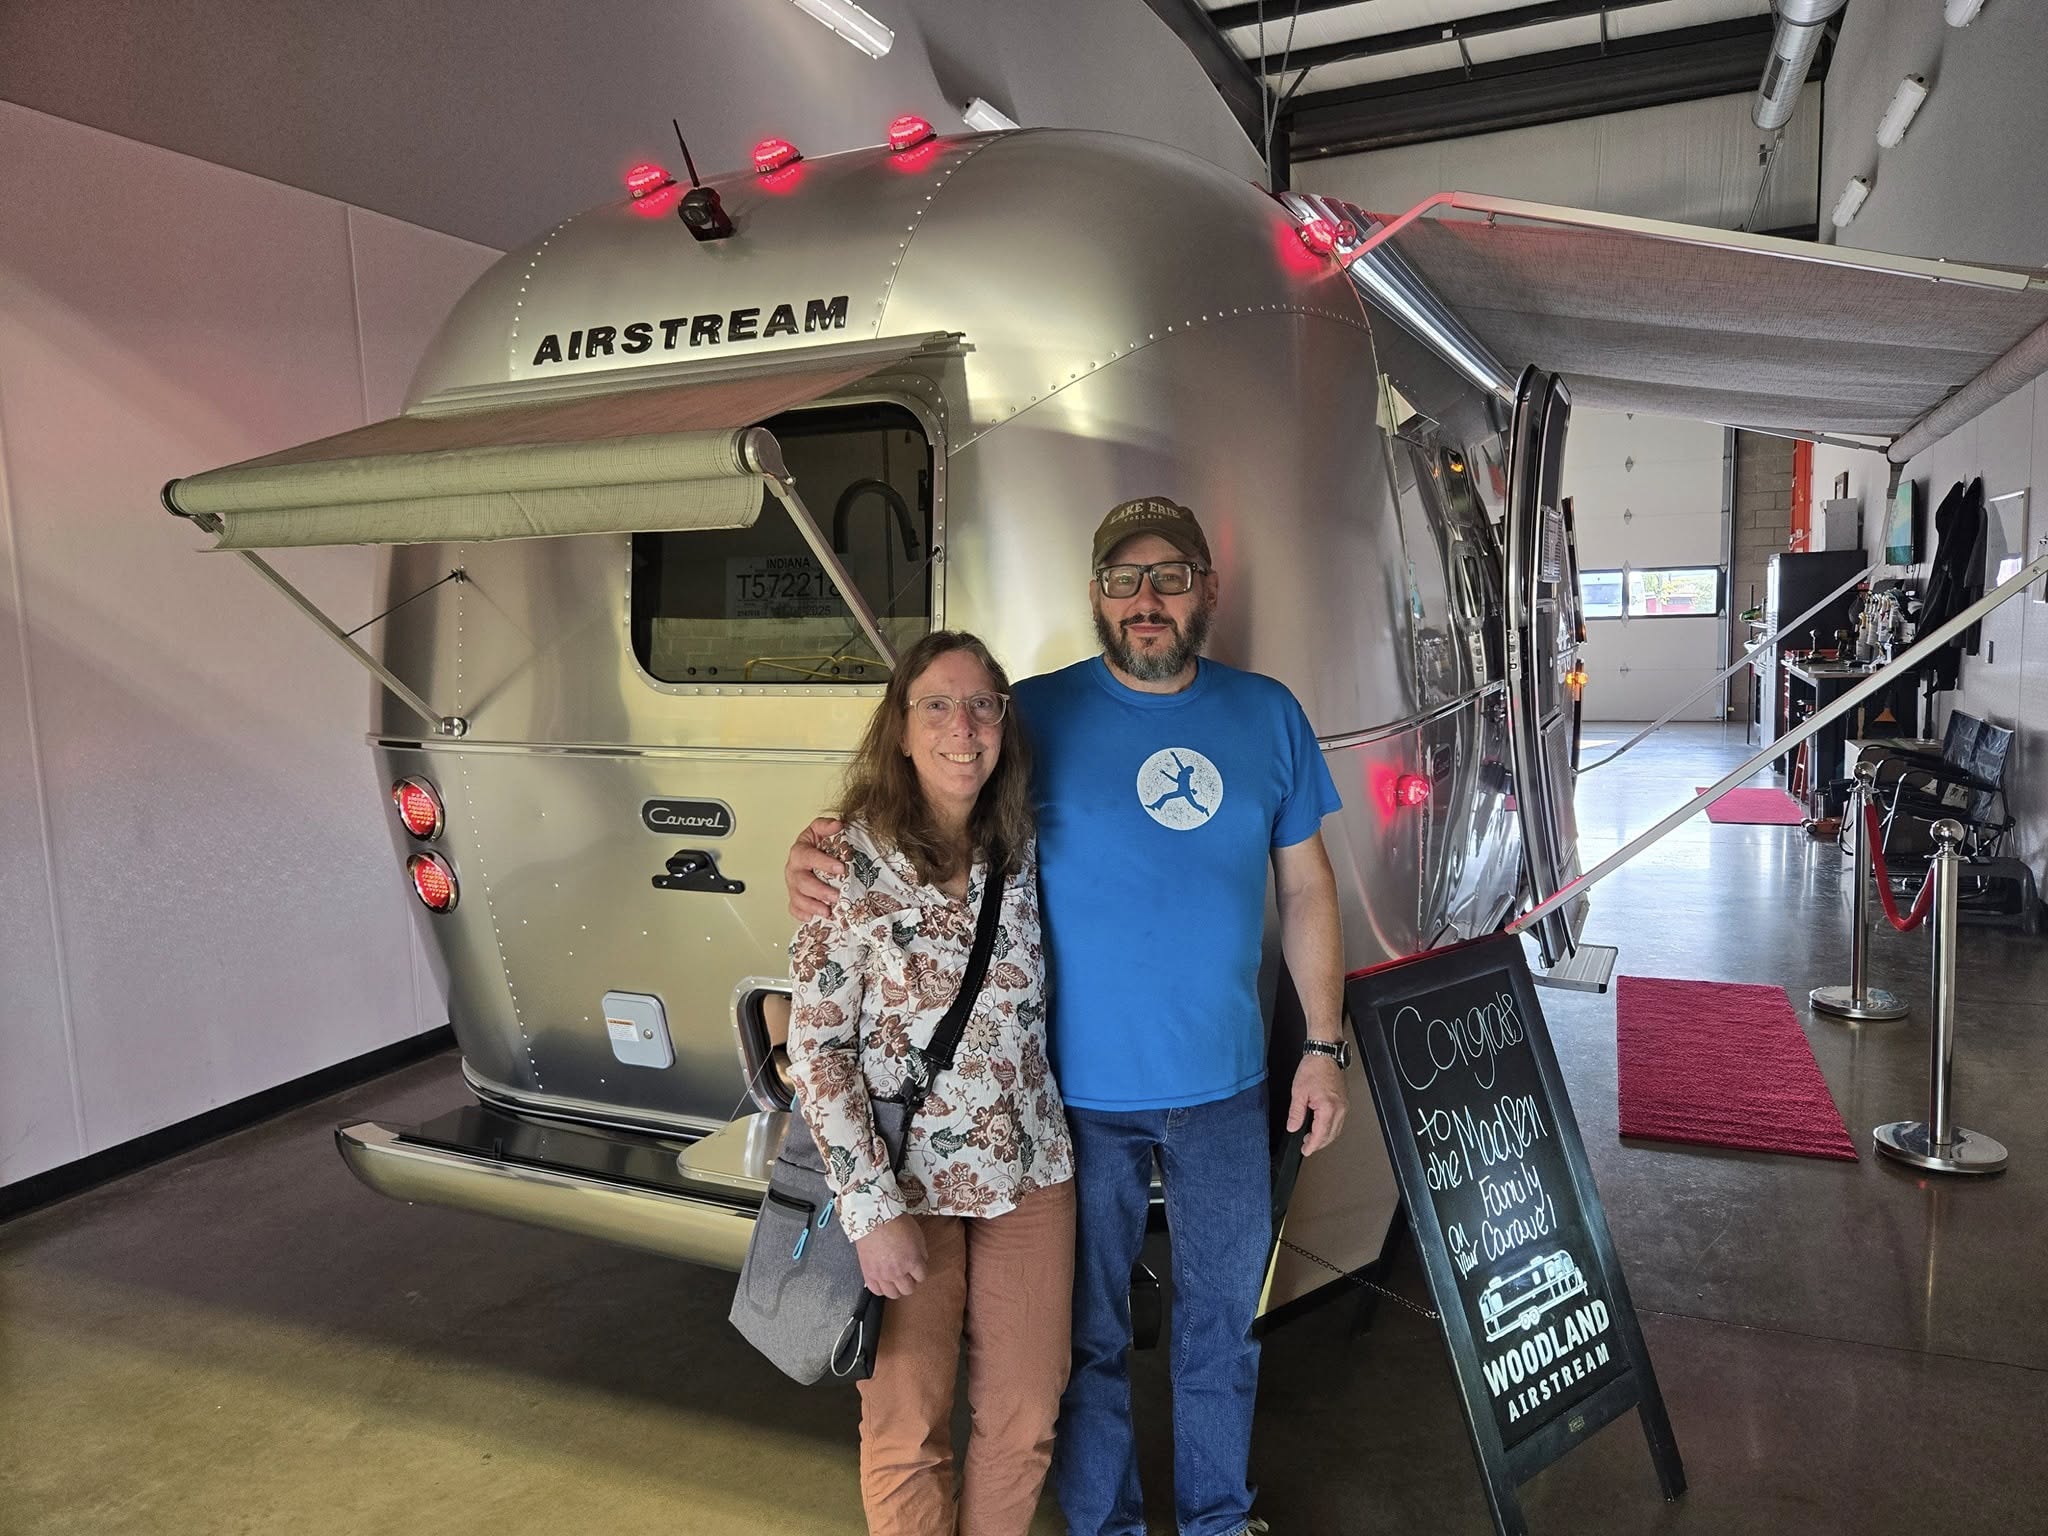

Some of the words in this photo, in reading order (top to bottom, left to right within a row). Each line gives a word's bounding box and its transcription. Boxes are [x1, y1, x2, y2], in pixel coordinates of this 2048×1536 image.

[533, 296, 850, 365] AIRSTREAM
[1110, 502, 1144, 524] LAKE
[1149, 502, 1180, 518] ERIE
[766, 558, 810, 569] INDIANA
[649, 807, 725, 828] Caravel
[1393, 991, 1523, 1090] Congrats
[1417, 1108, 1451, 1147] to
[1427, 1150, 1462, 1190] the
[1478, 1162, 1545, 1218] Family
[1449, 1222, 1471, 1254] on
[1481, 1193, 1557, 1262] Caravel
[1482, 1299, 1610, 1398] WOODLAND
[1508, 1342, 1610, 1423] AIRSTREAM
